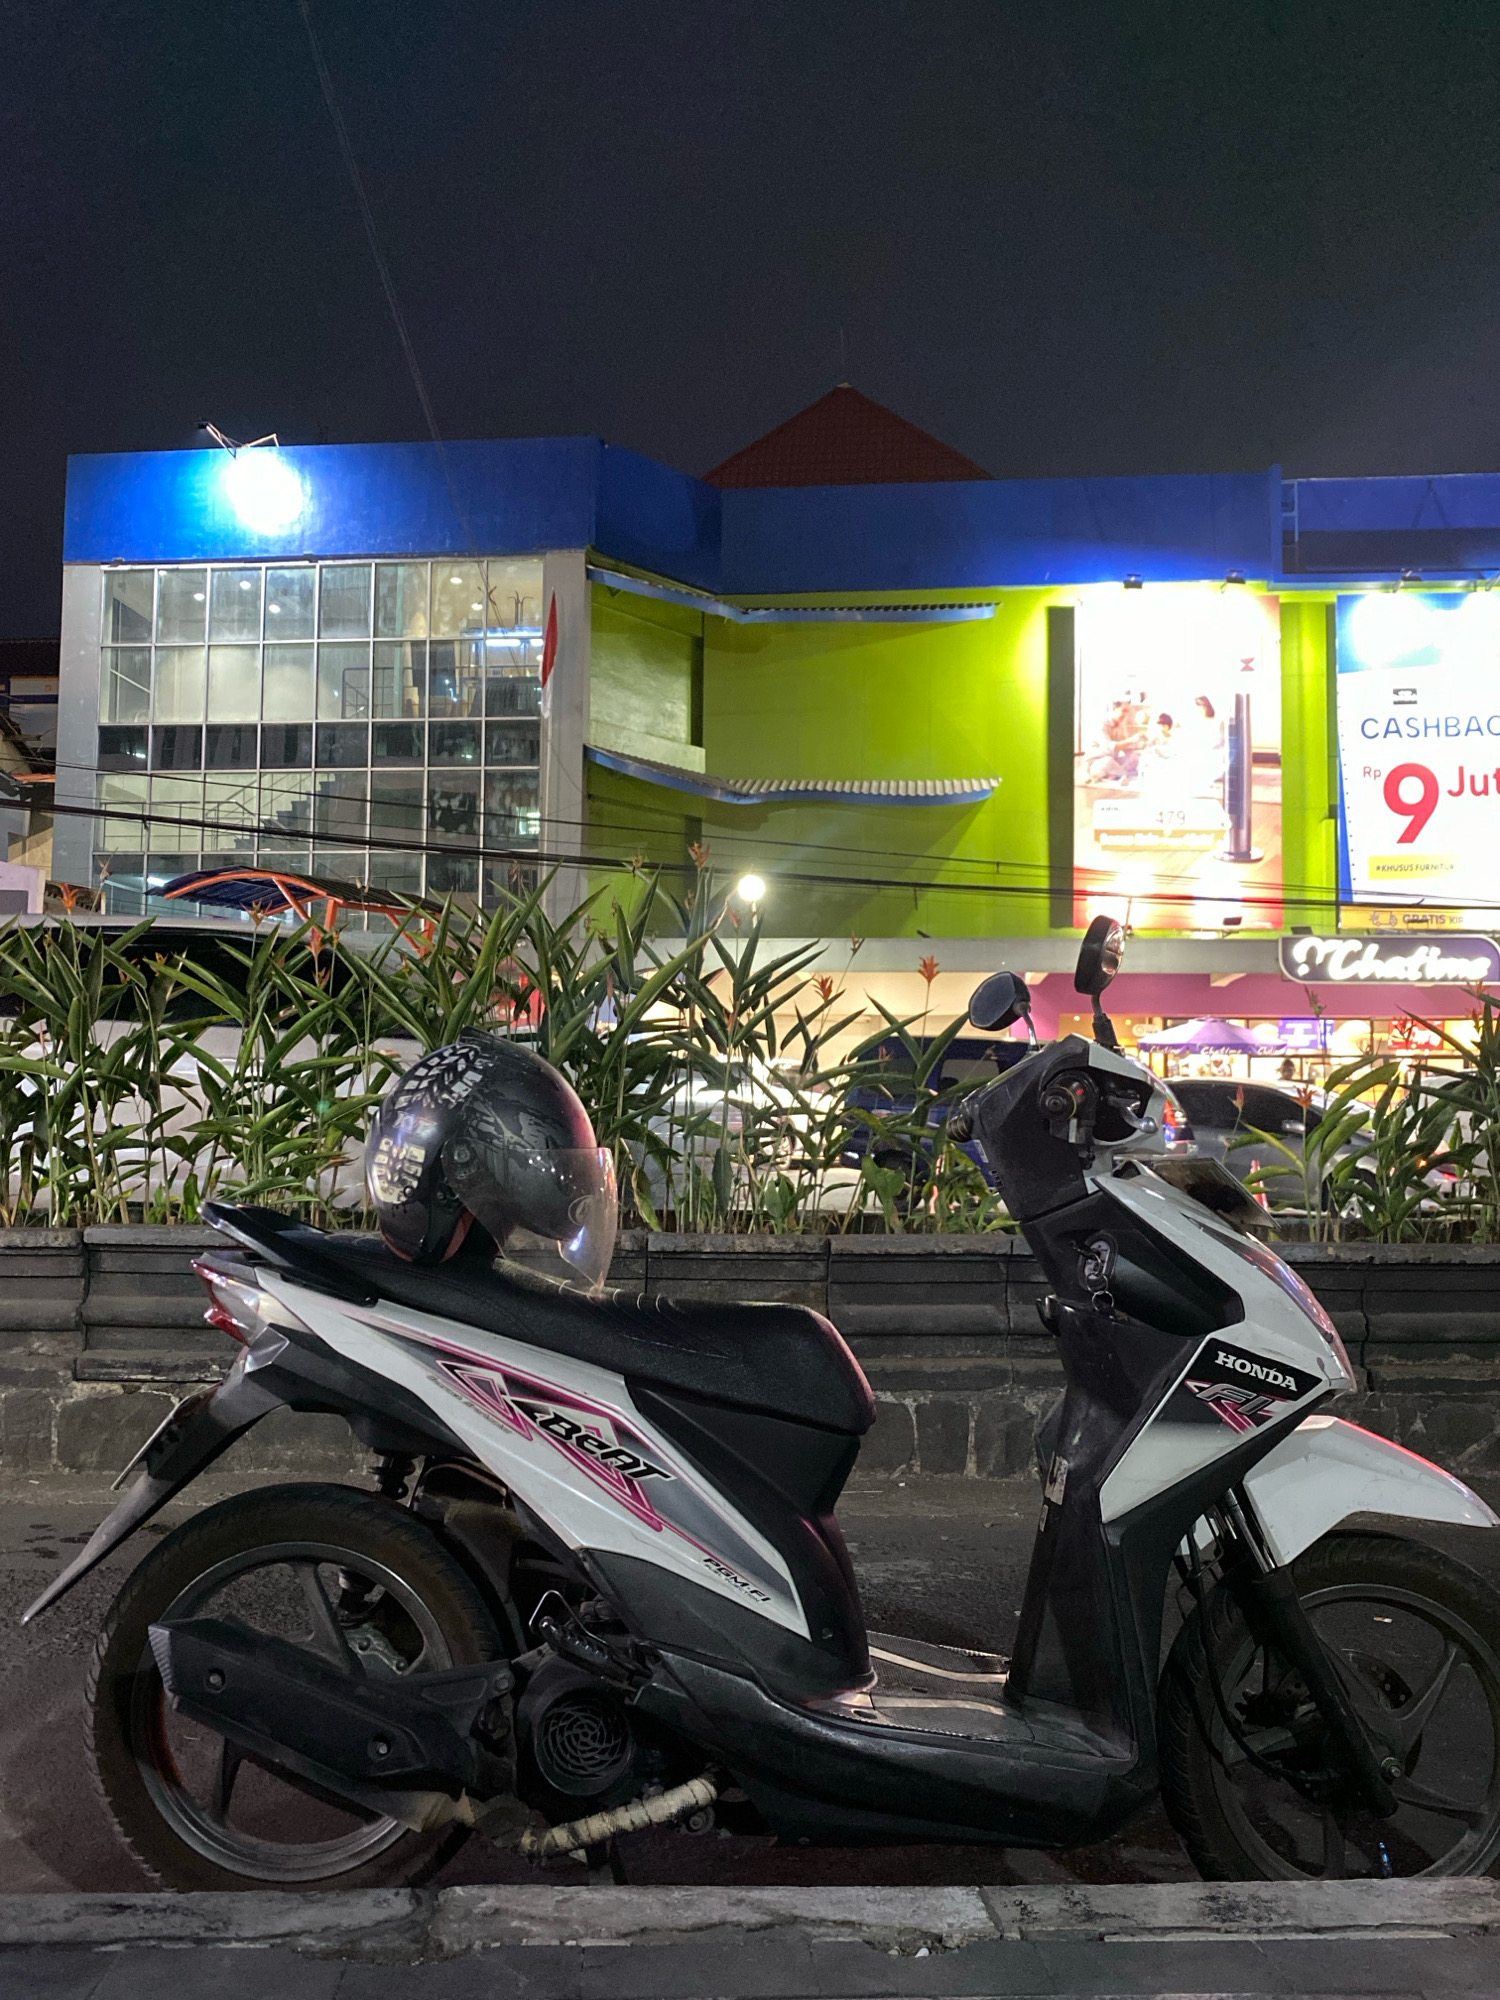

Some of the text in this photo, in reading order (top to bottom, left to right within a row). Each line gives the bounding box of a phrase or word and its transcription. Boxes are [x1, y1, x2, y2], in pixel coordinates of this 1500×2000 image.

[1363, 766, 1381, 780] Rp
[1383, 763, 1439, 844] 9
[1325, 939, 1491, 980] Chatime
[1214, 1351, 1298, 1391] HONDA
